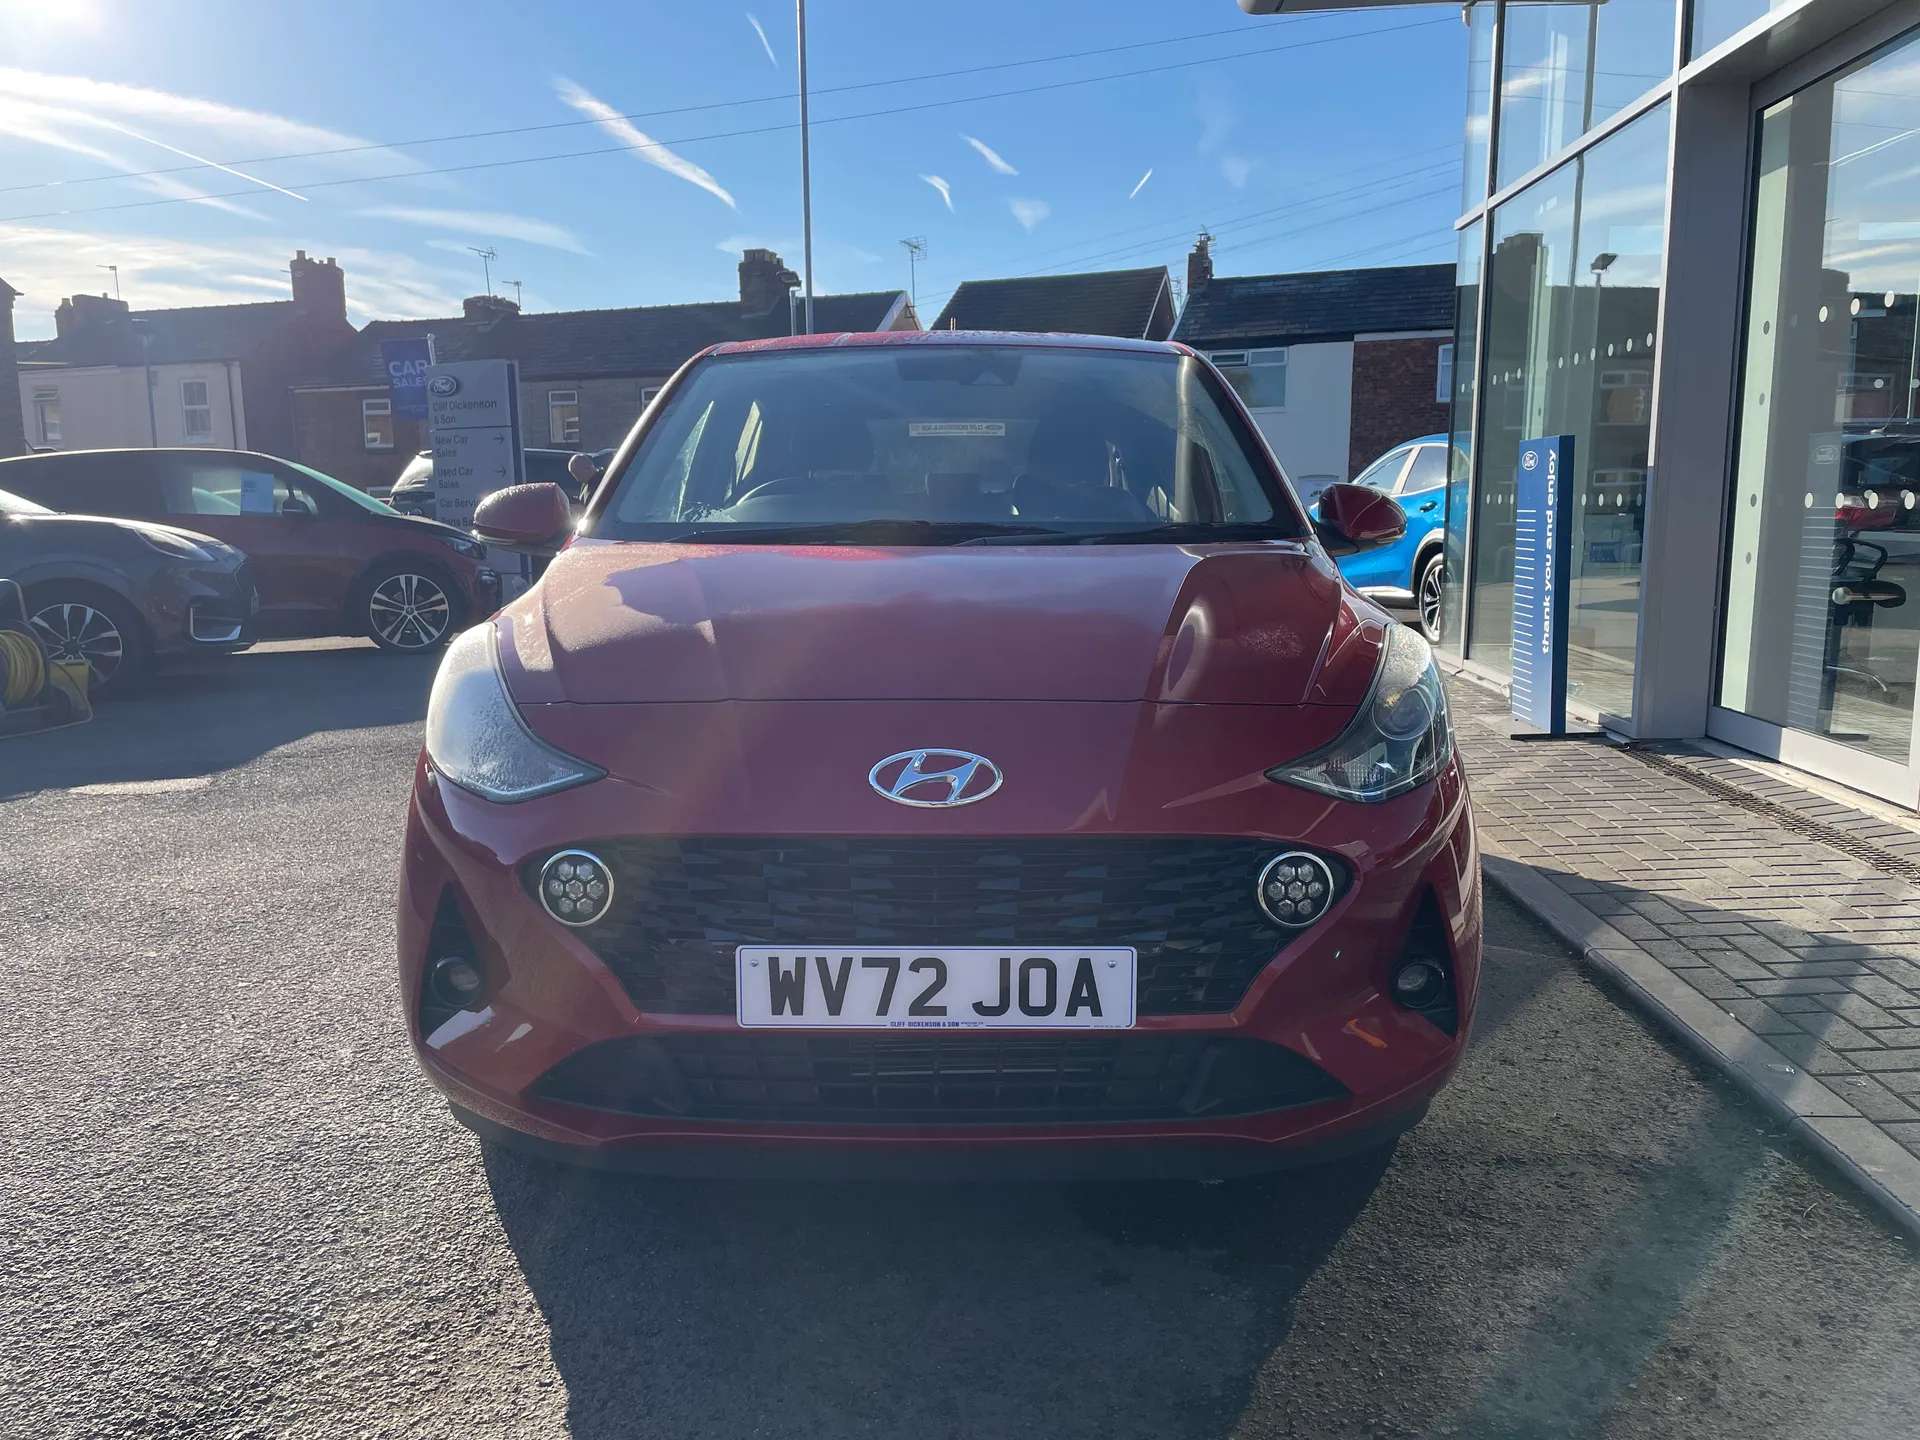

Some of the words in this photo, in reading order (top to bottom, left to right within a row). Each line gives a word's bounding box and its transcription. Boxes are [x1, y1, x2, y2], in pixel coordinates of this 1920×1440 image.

[441, 414, 456, 424] Son
[435, 435, 452, 445] New
[453, 434, 468, 444] Car
[436, 448, 457, 458] Sales
[438, 466, 457, 476] Used
[458, 466, 473, 476] Car
[439, 480, 460, 489] Sales
[440, 498, 453, 508] Car
[1542, 595, 1551, 655] thank
[1547, 448, 1557, 506] enjoy
[767, 956, 948, 1017] WV72
[971, 956, 1104, 1017] JOA
